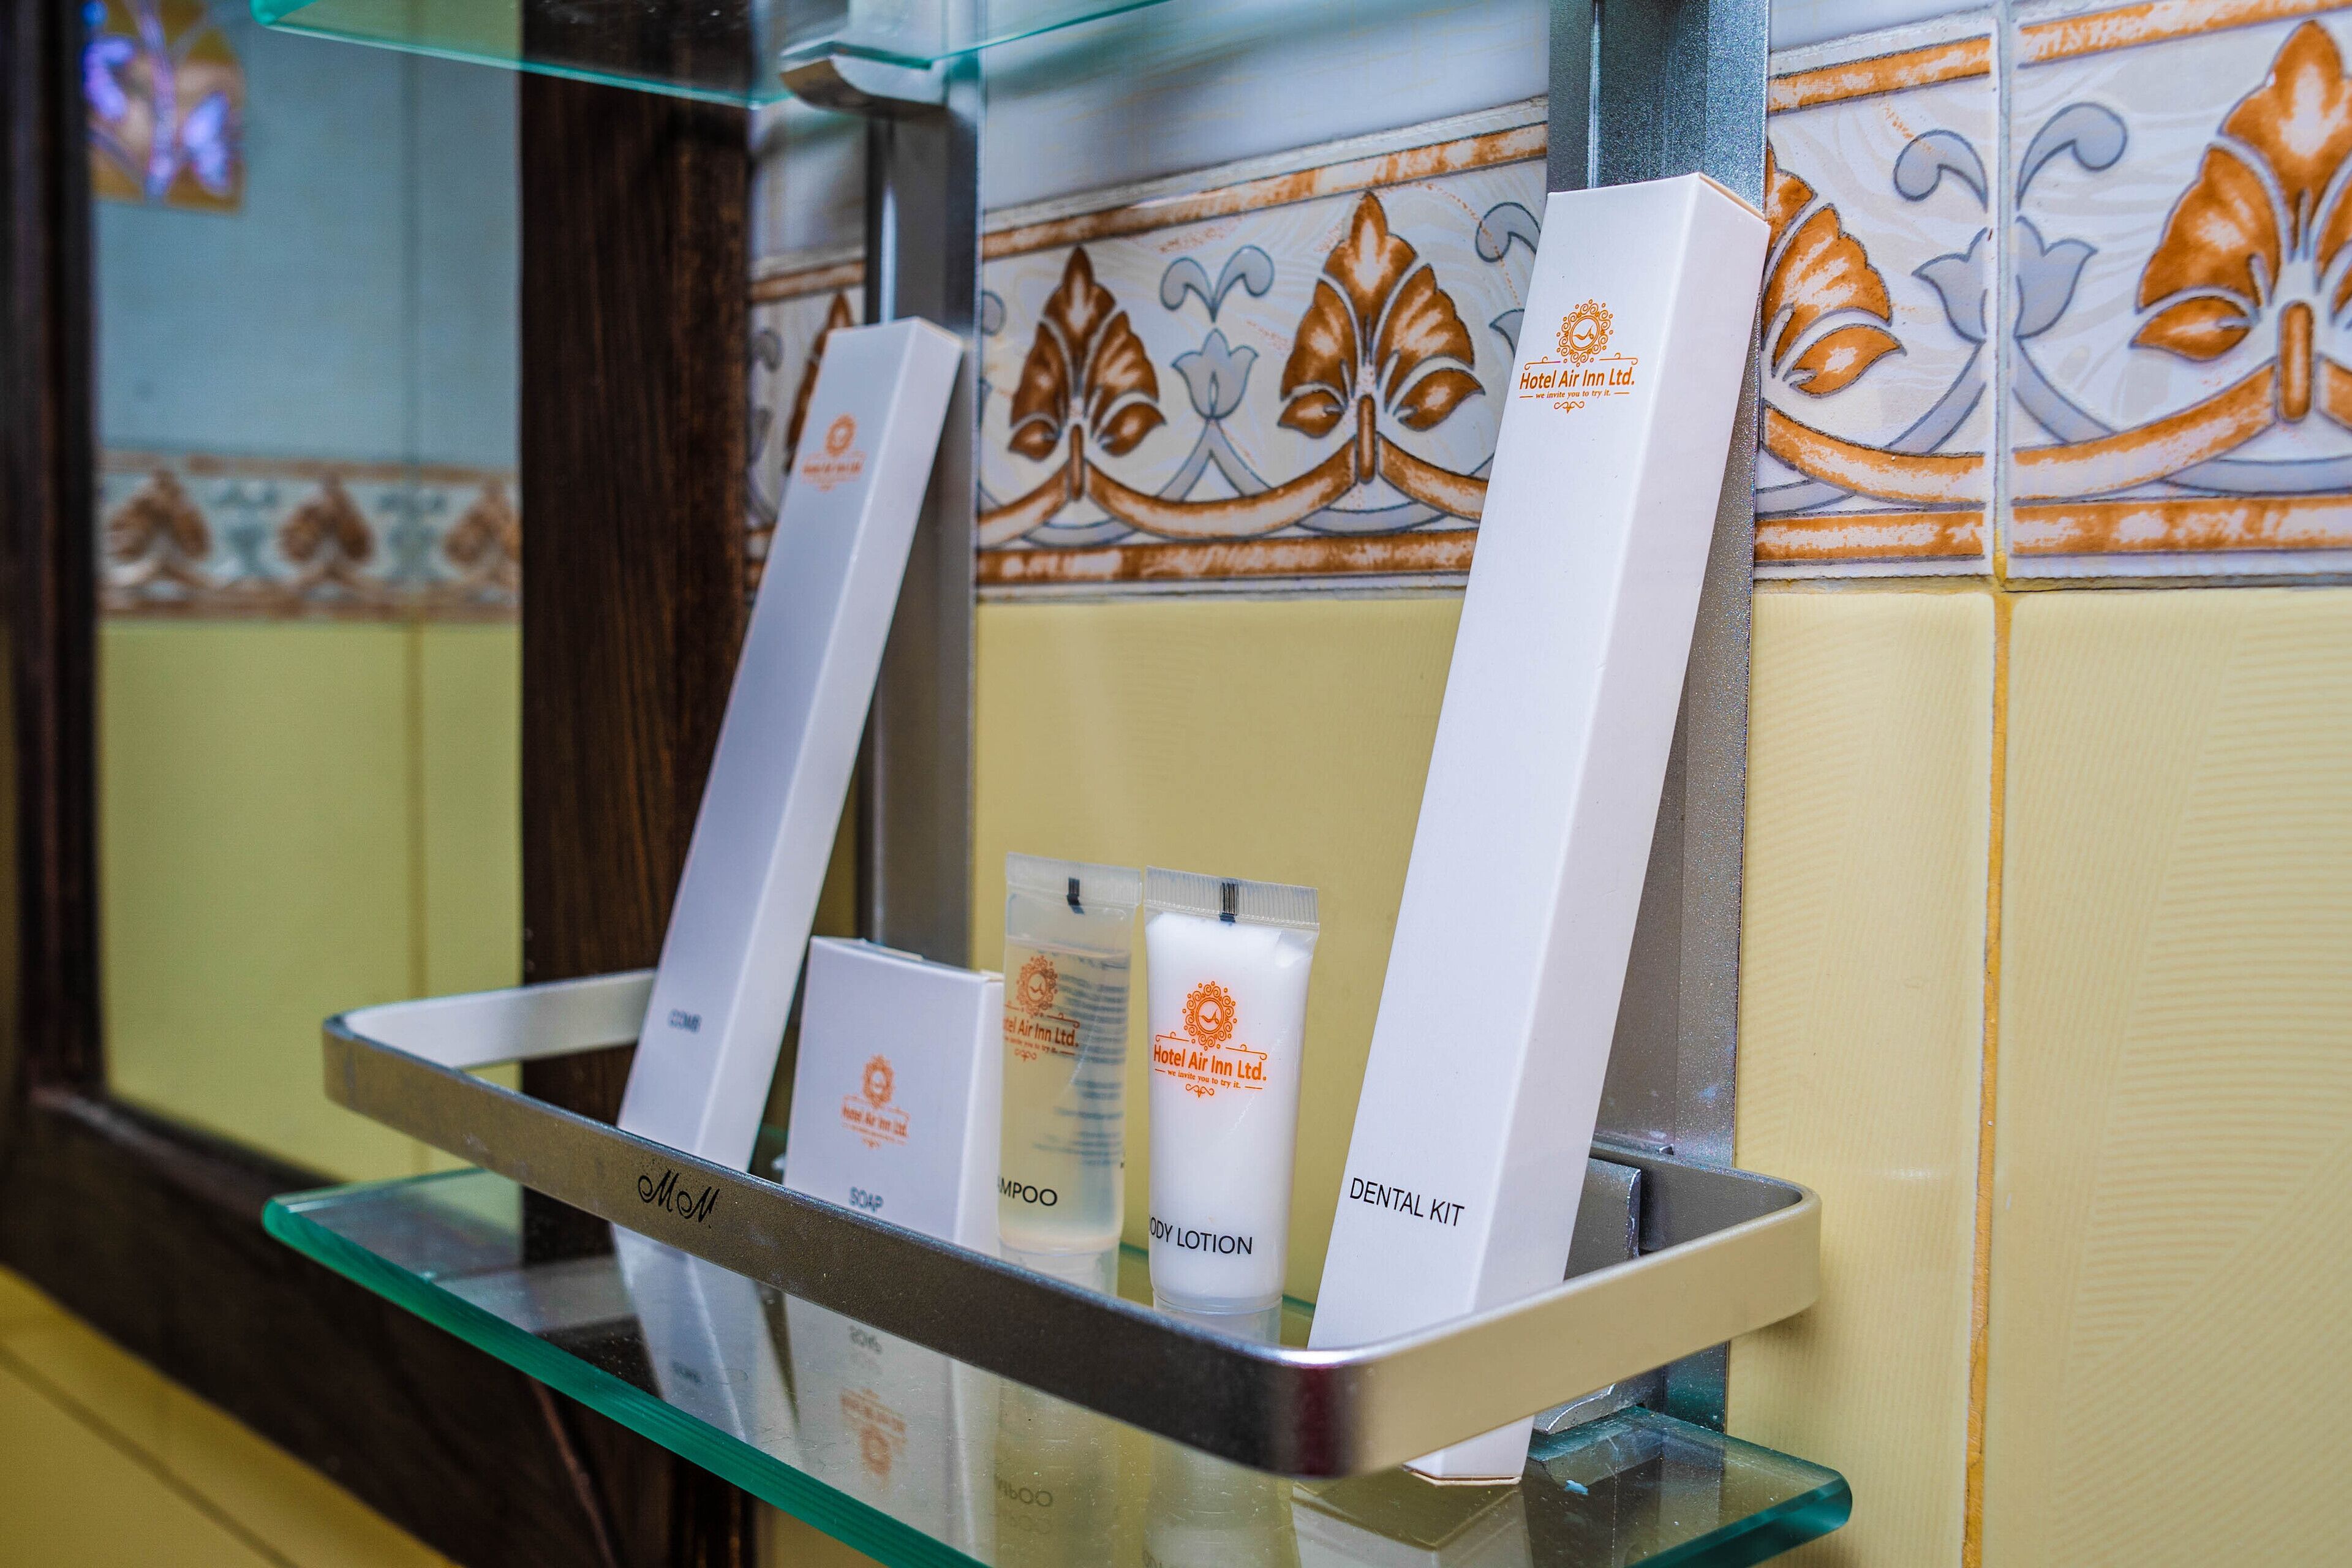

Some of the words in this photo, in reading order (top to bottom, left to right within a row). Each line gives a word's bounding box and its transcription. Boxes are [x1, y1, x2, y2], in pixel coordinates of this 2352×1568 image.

[1520, 369, 1557, 390] Hotel
[1558, 369, 1580, 388] Air
[1582, 369, 1605, 386] Inn
[1608, 366, 1635, 386] Ltd.
[1567, 391, 1580, 400] you
[1592, 390, 1603, 398] try
[1018, 1019, 1033, 1037] Air
[1035, 1023, 1052, 1042] Inn
[1055, 1027, 1079, 1047] Ltd.
[1153, 1044, 1186, 1067] Hotel
[1188, 1052, 1208, 1071] Air
[1210, 1055, 1232, 1076] Inn
[1237, 1060, 1267, 1081] Ltd.
[1178, 1069, 1196, 1080] invite
[1220, 1079, 1231, 1088] try
[850, 1186, 884, 1213] SOAP
[998, 1176, 1058, 1206] MPOO
[1349, 1177, 1424, 1218] DENTAL
[1430, 1199, 1465, 1227] KIT
[1149, 1216, 1174, 1243] ODY
[1177, 1227, 1253, 1255] LOTION
